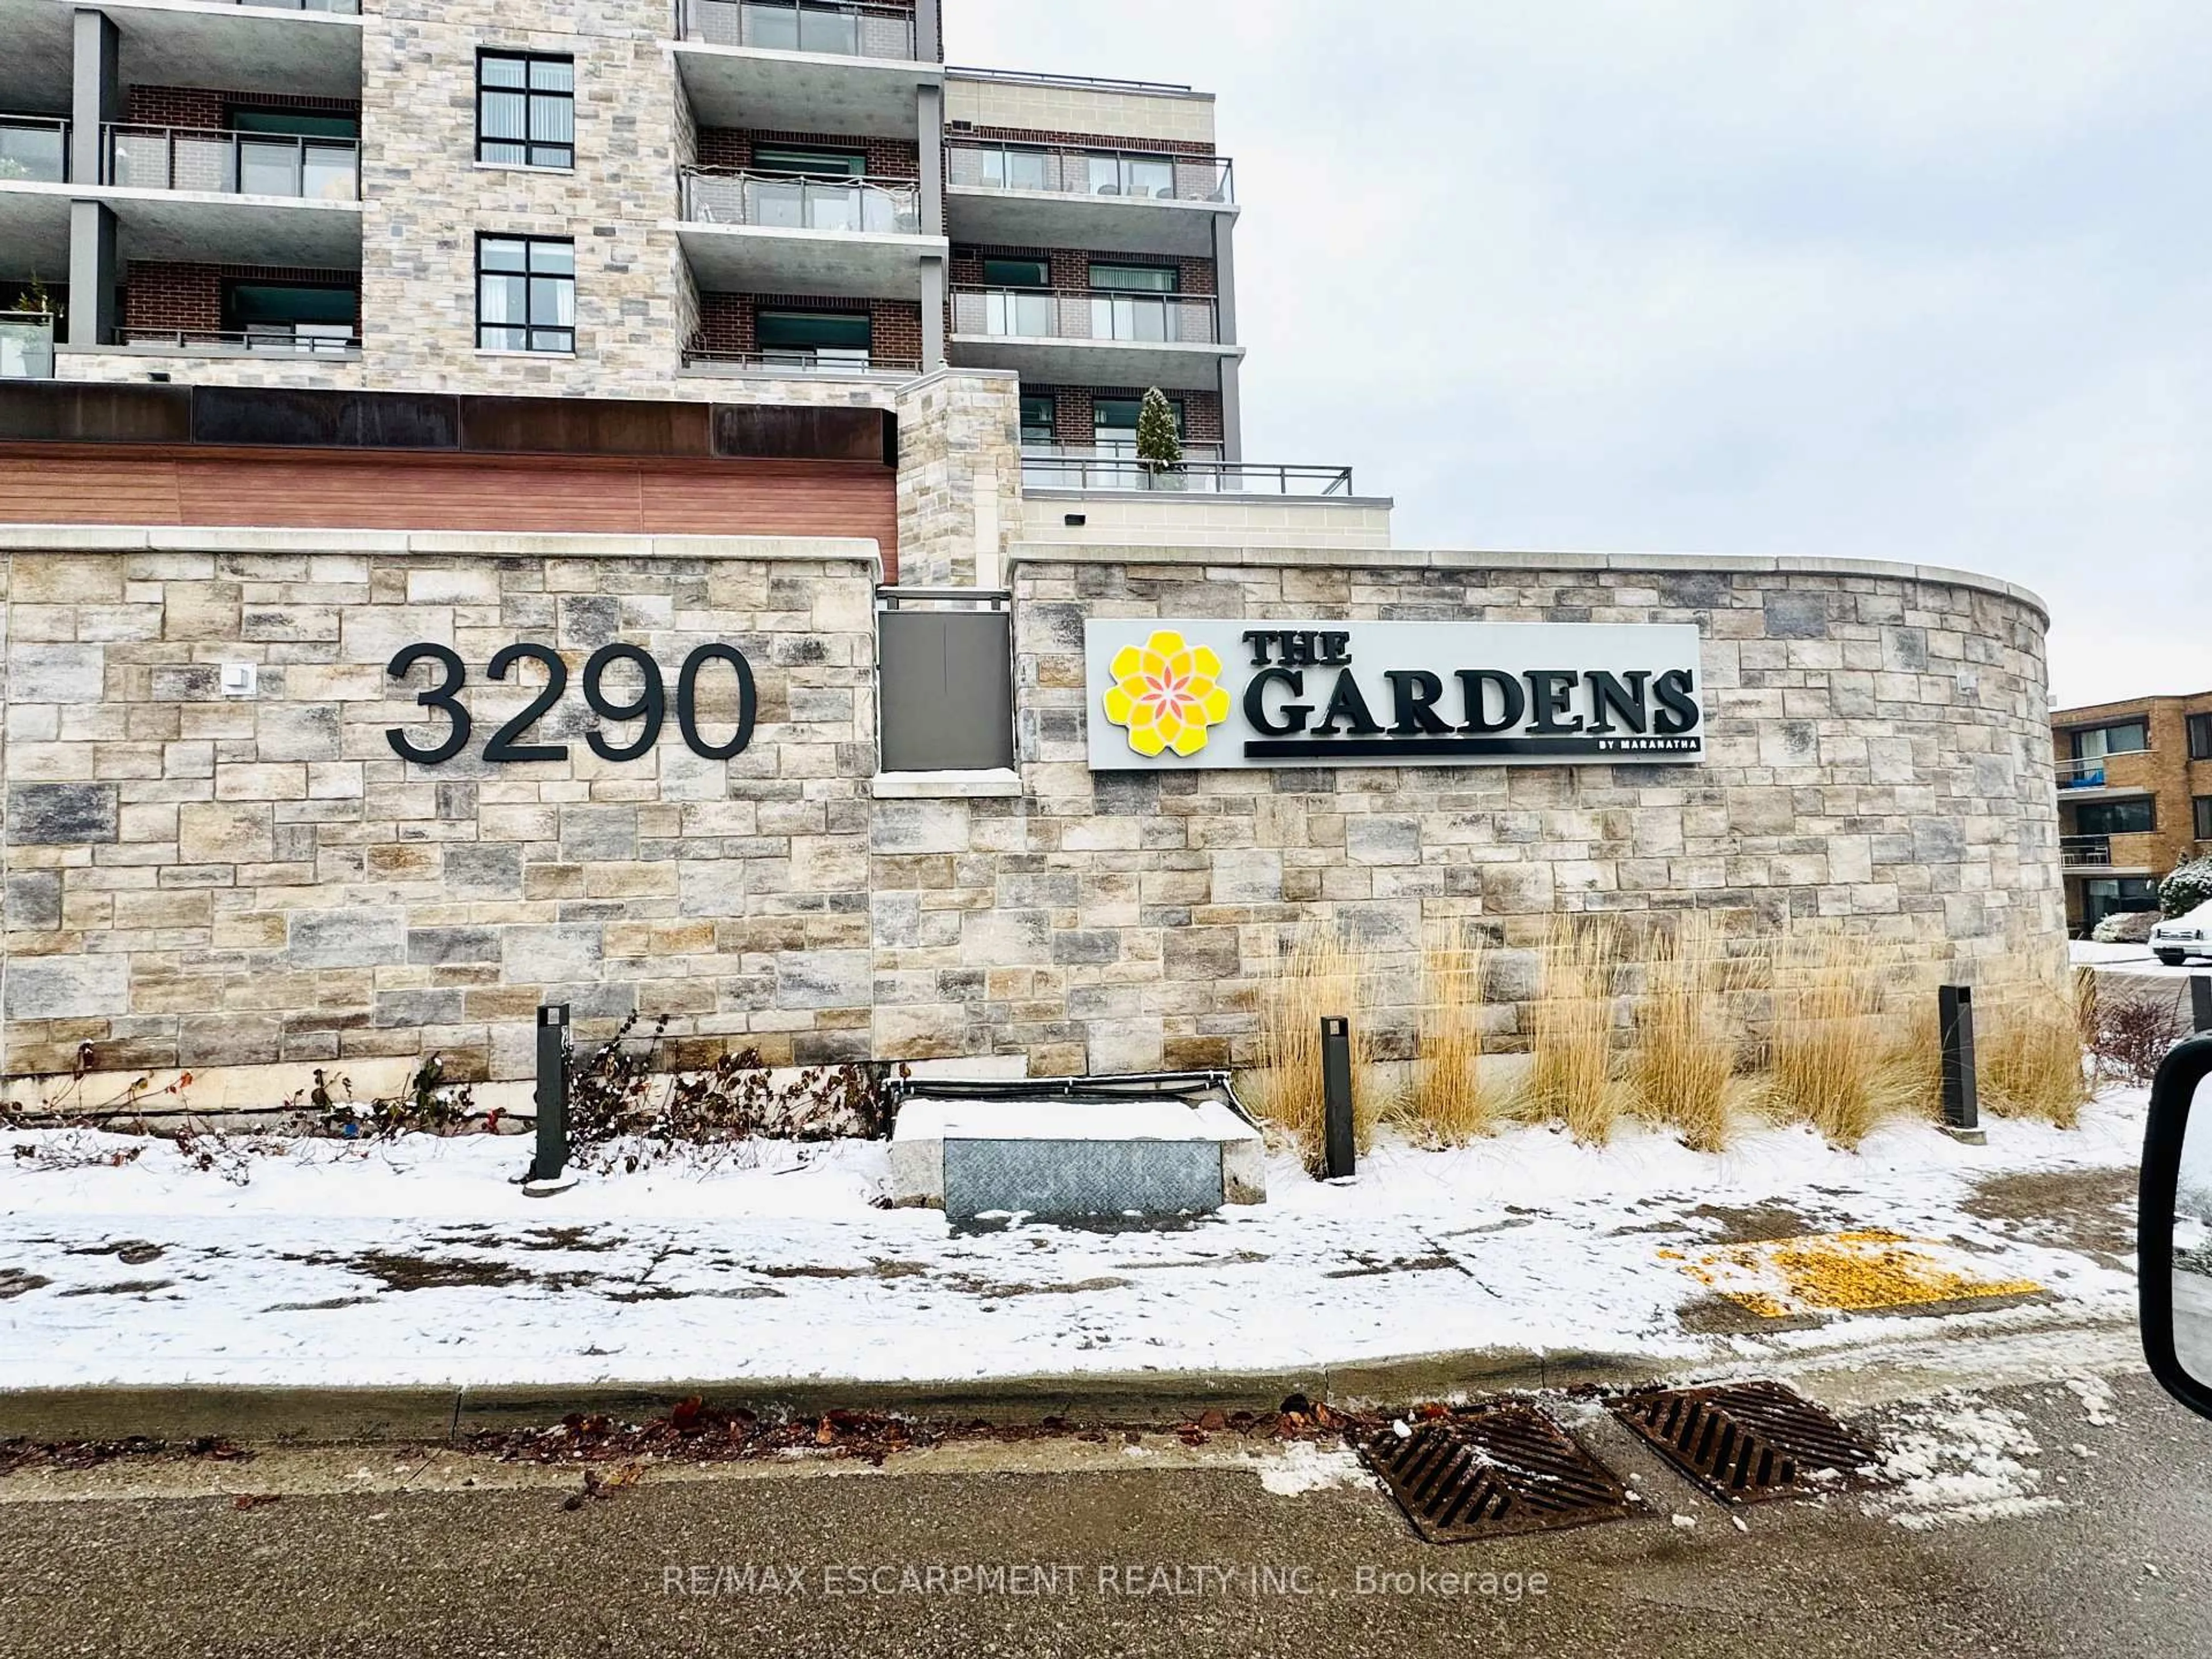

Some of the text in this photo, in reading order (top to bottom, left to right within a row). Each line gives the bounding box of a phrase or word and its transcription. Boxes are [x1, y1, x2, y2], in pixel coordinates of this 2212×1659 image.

[1243, 630, 1352, 666] THE
[386, 642, 757, 763] 3290
[1243, 667, 1699, 734] GARDENS
[1599, 740, 1697, 749] BY MARANATHA
